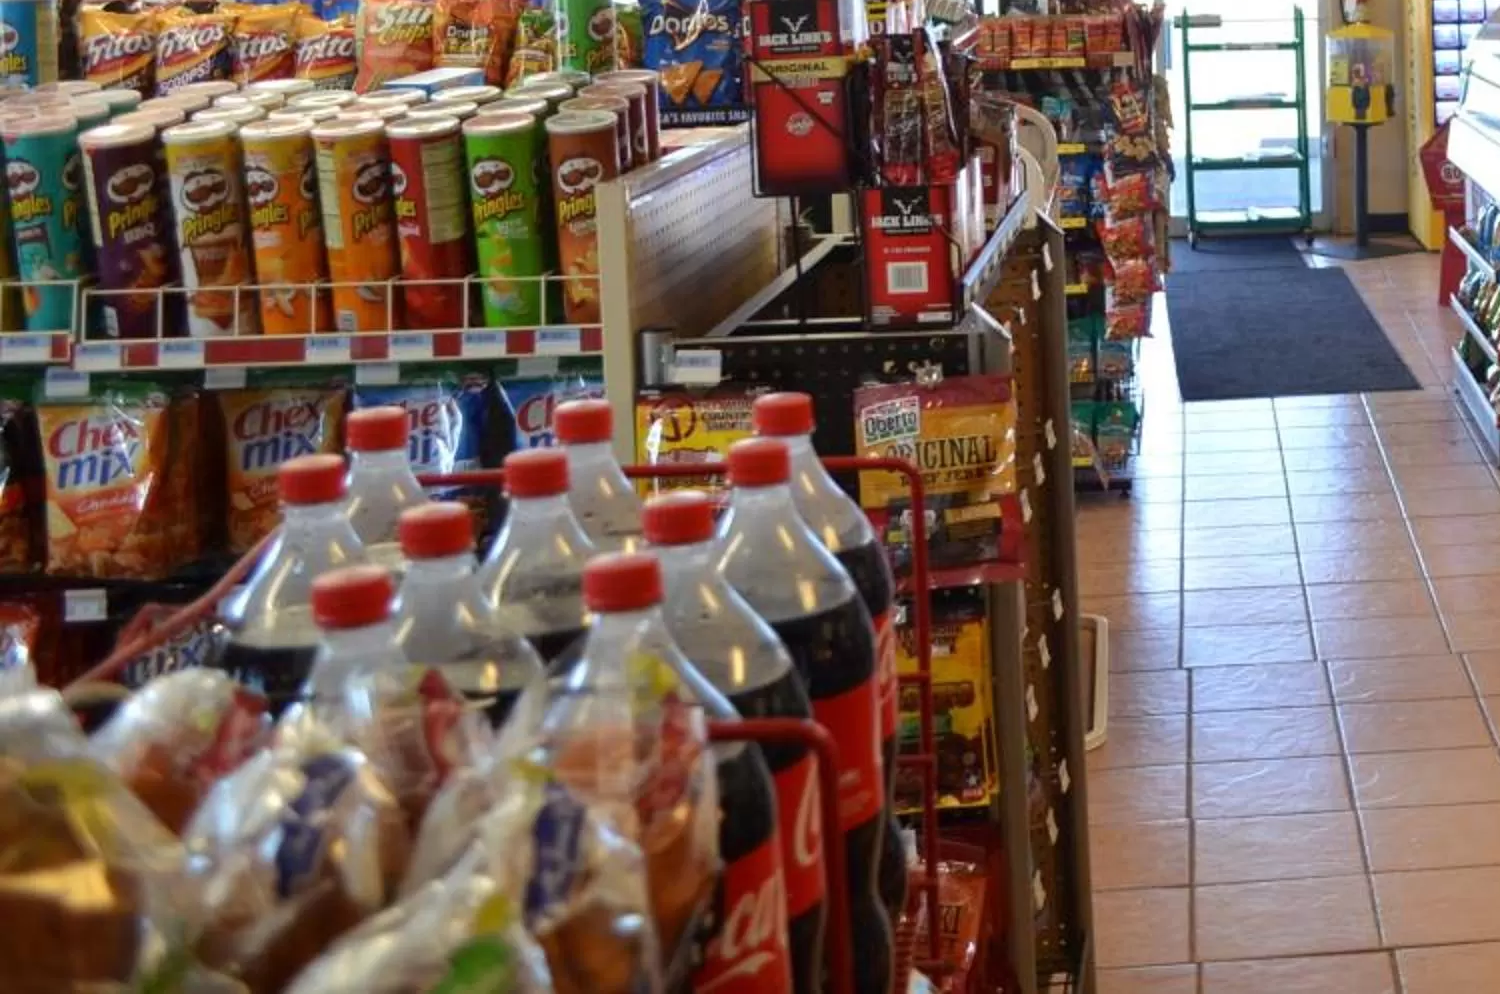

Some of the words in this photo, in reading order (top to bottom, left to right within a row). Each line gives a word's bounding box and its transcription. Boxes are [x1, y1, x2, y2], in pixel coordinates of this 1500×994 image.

[86, 29, 152, 69] Fritos
[296, 36, 353, 62] Frito
[50, 416, 139, 458] Chex
[234, 399, 324, 440] Chex
[865, 411, 917, 435] Oberto
[57, 442, 138, 489] mix
[243, 420, 323, 471] mix
